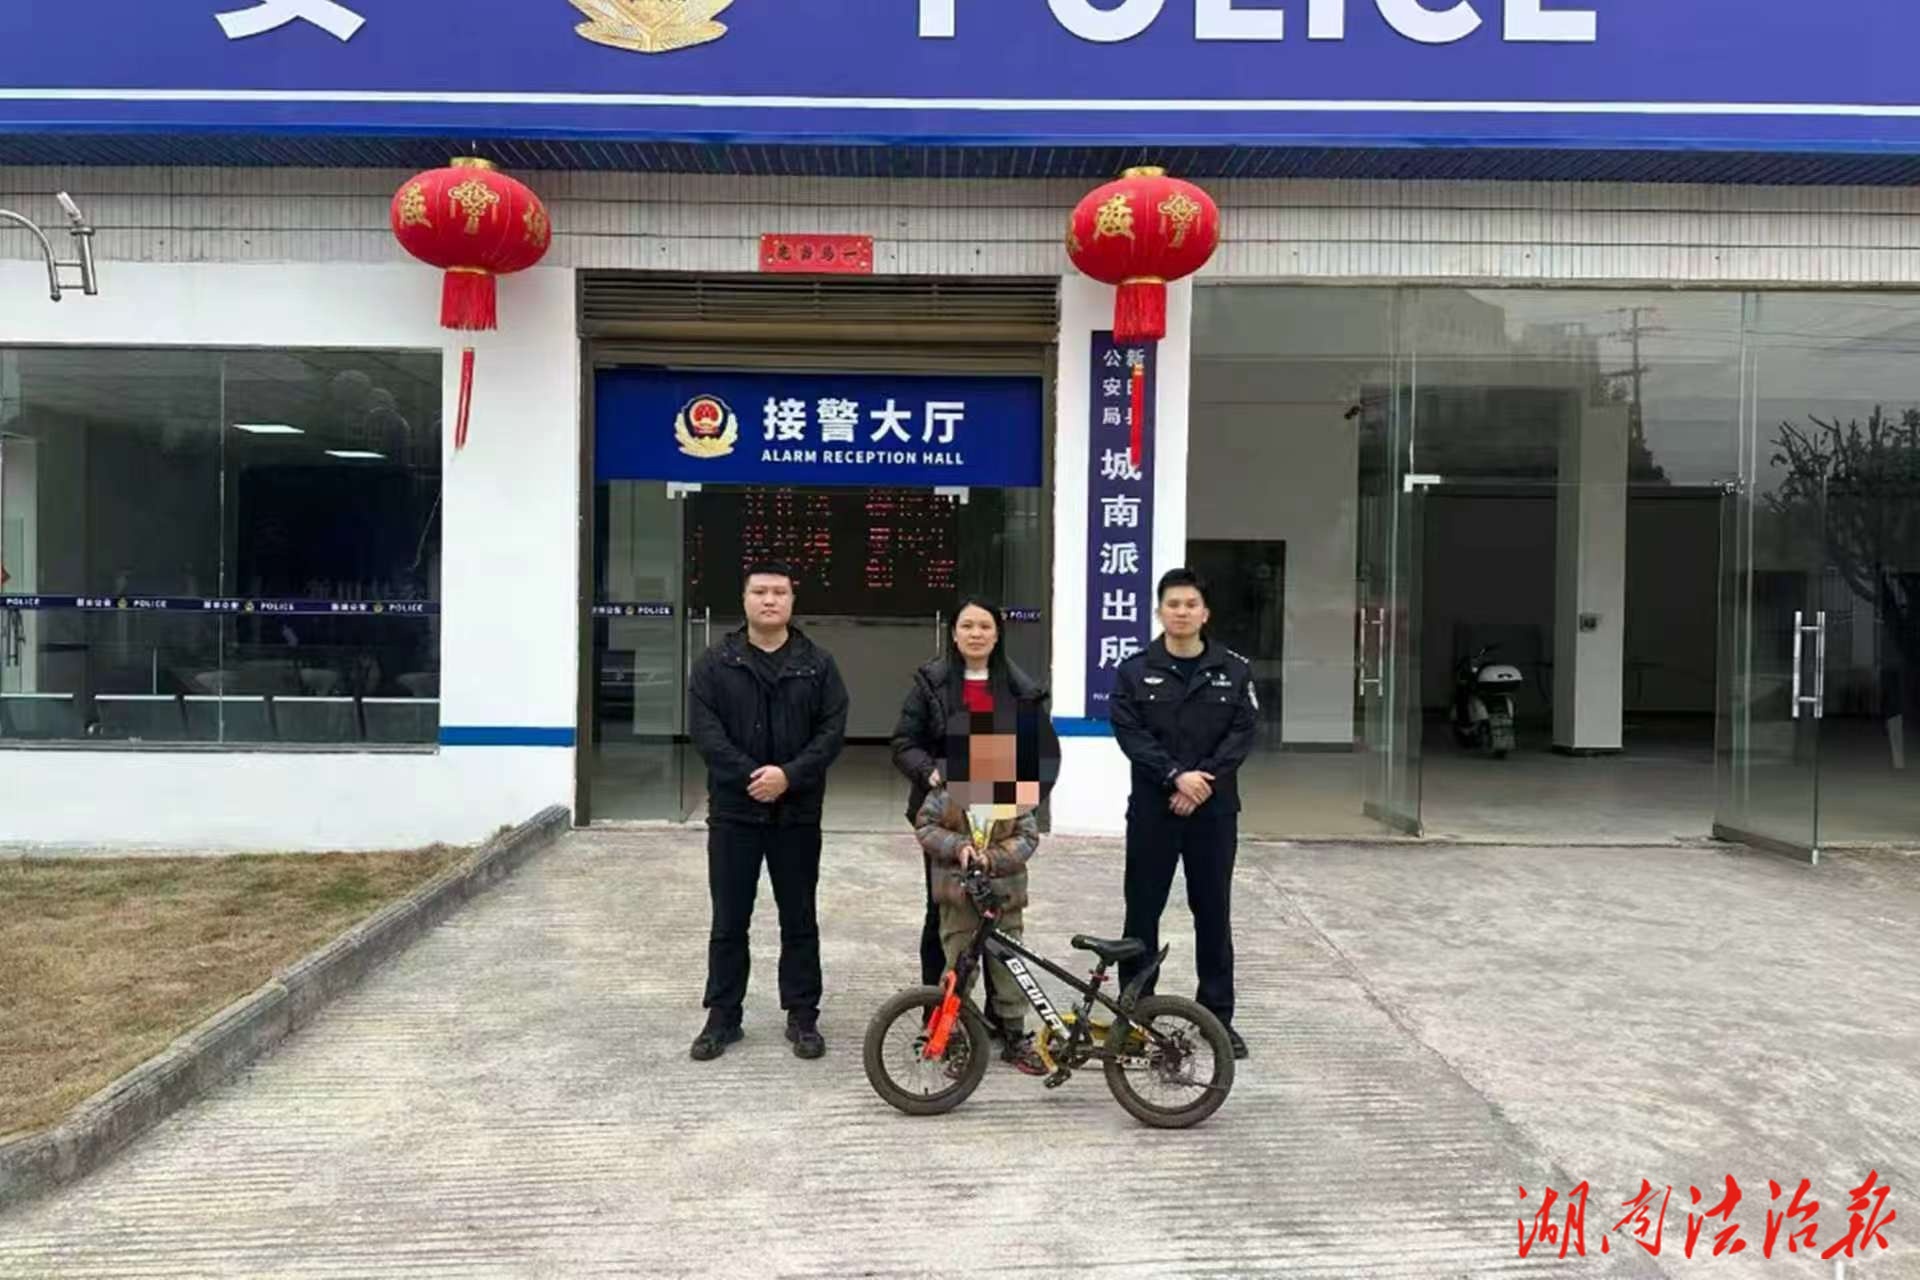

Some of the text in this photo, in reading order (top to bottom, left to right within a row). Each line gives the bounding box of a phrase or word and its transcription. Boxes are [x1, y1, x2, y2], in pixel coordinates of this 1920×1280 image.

[1102, 348, 1122, 426] 公安局
[762, 397, 965, 443] 接警大厅
[761, 448, 964, 465] ALARM RECEPTION HALL
[1100, 447, 1142, 669] 城南派出所
[133, 599, 168, 609] POLICE
[260, 602, 295, 612] POLICE
[388, 603, 423, 613] POLICE
